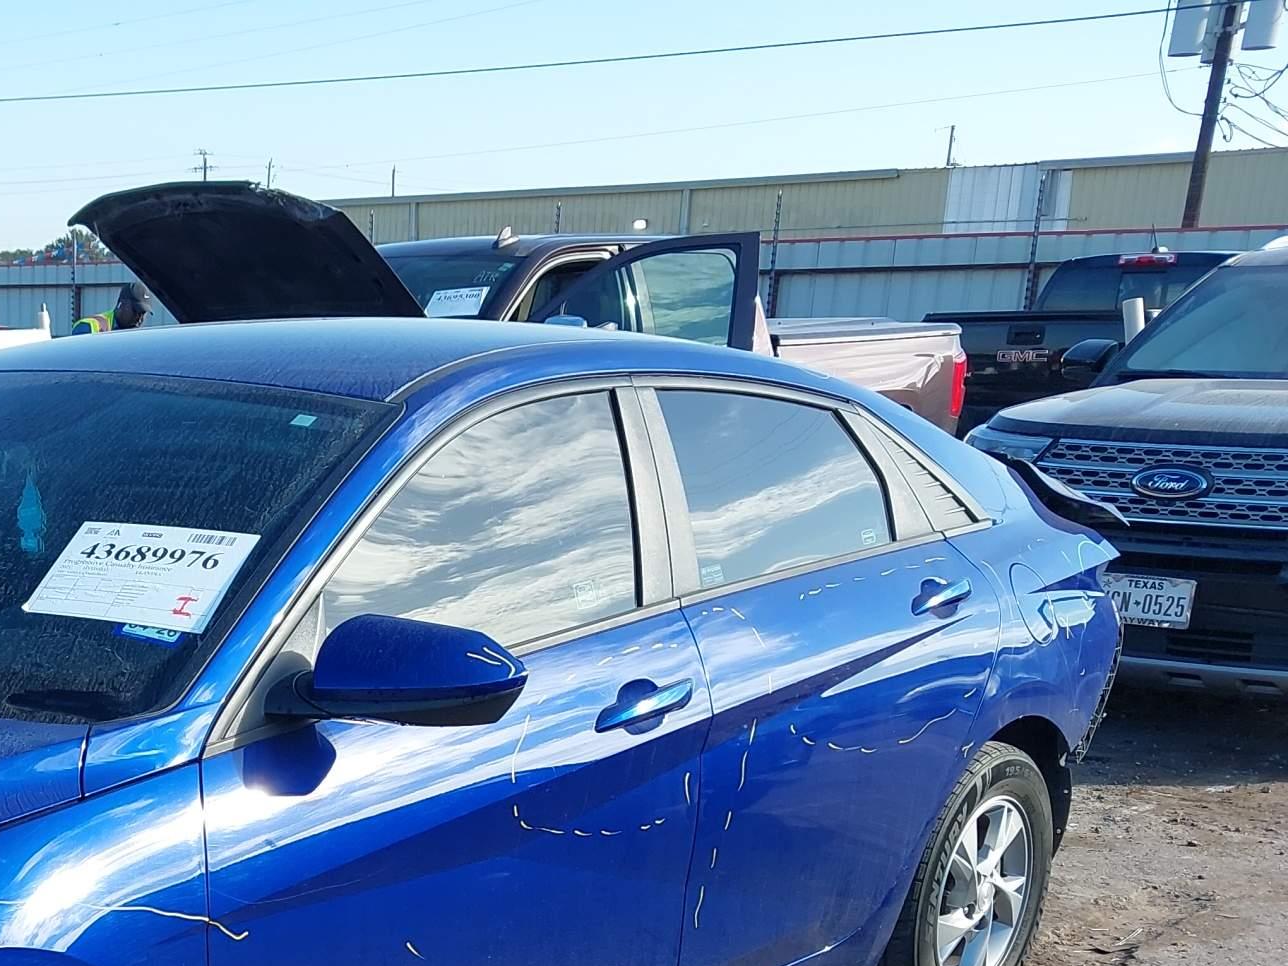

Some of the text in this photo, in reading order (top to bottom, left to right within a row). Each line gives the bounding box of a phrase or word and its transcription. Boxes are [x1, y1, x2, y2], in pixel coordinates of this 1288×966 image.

[997, 350, 1049, 362] GMC
[1148, 474, 1190, 489] Ford
[80, 542, 224, 570] 43689976
[1128, 579, 1165, 591] TEXAS
[1141, 594, 1187, 617] 0525
